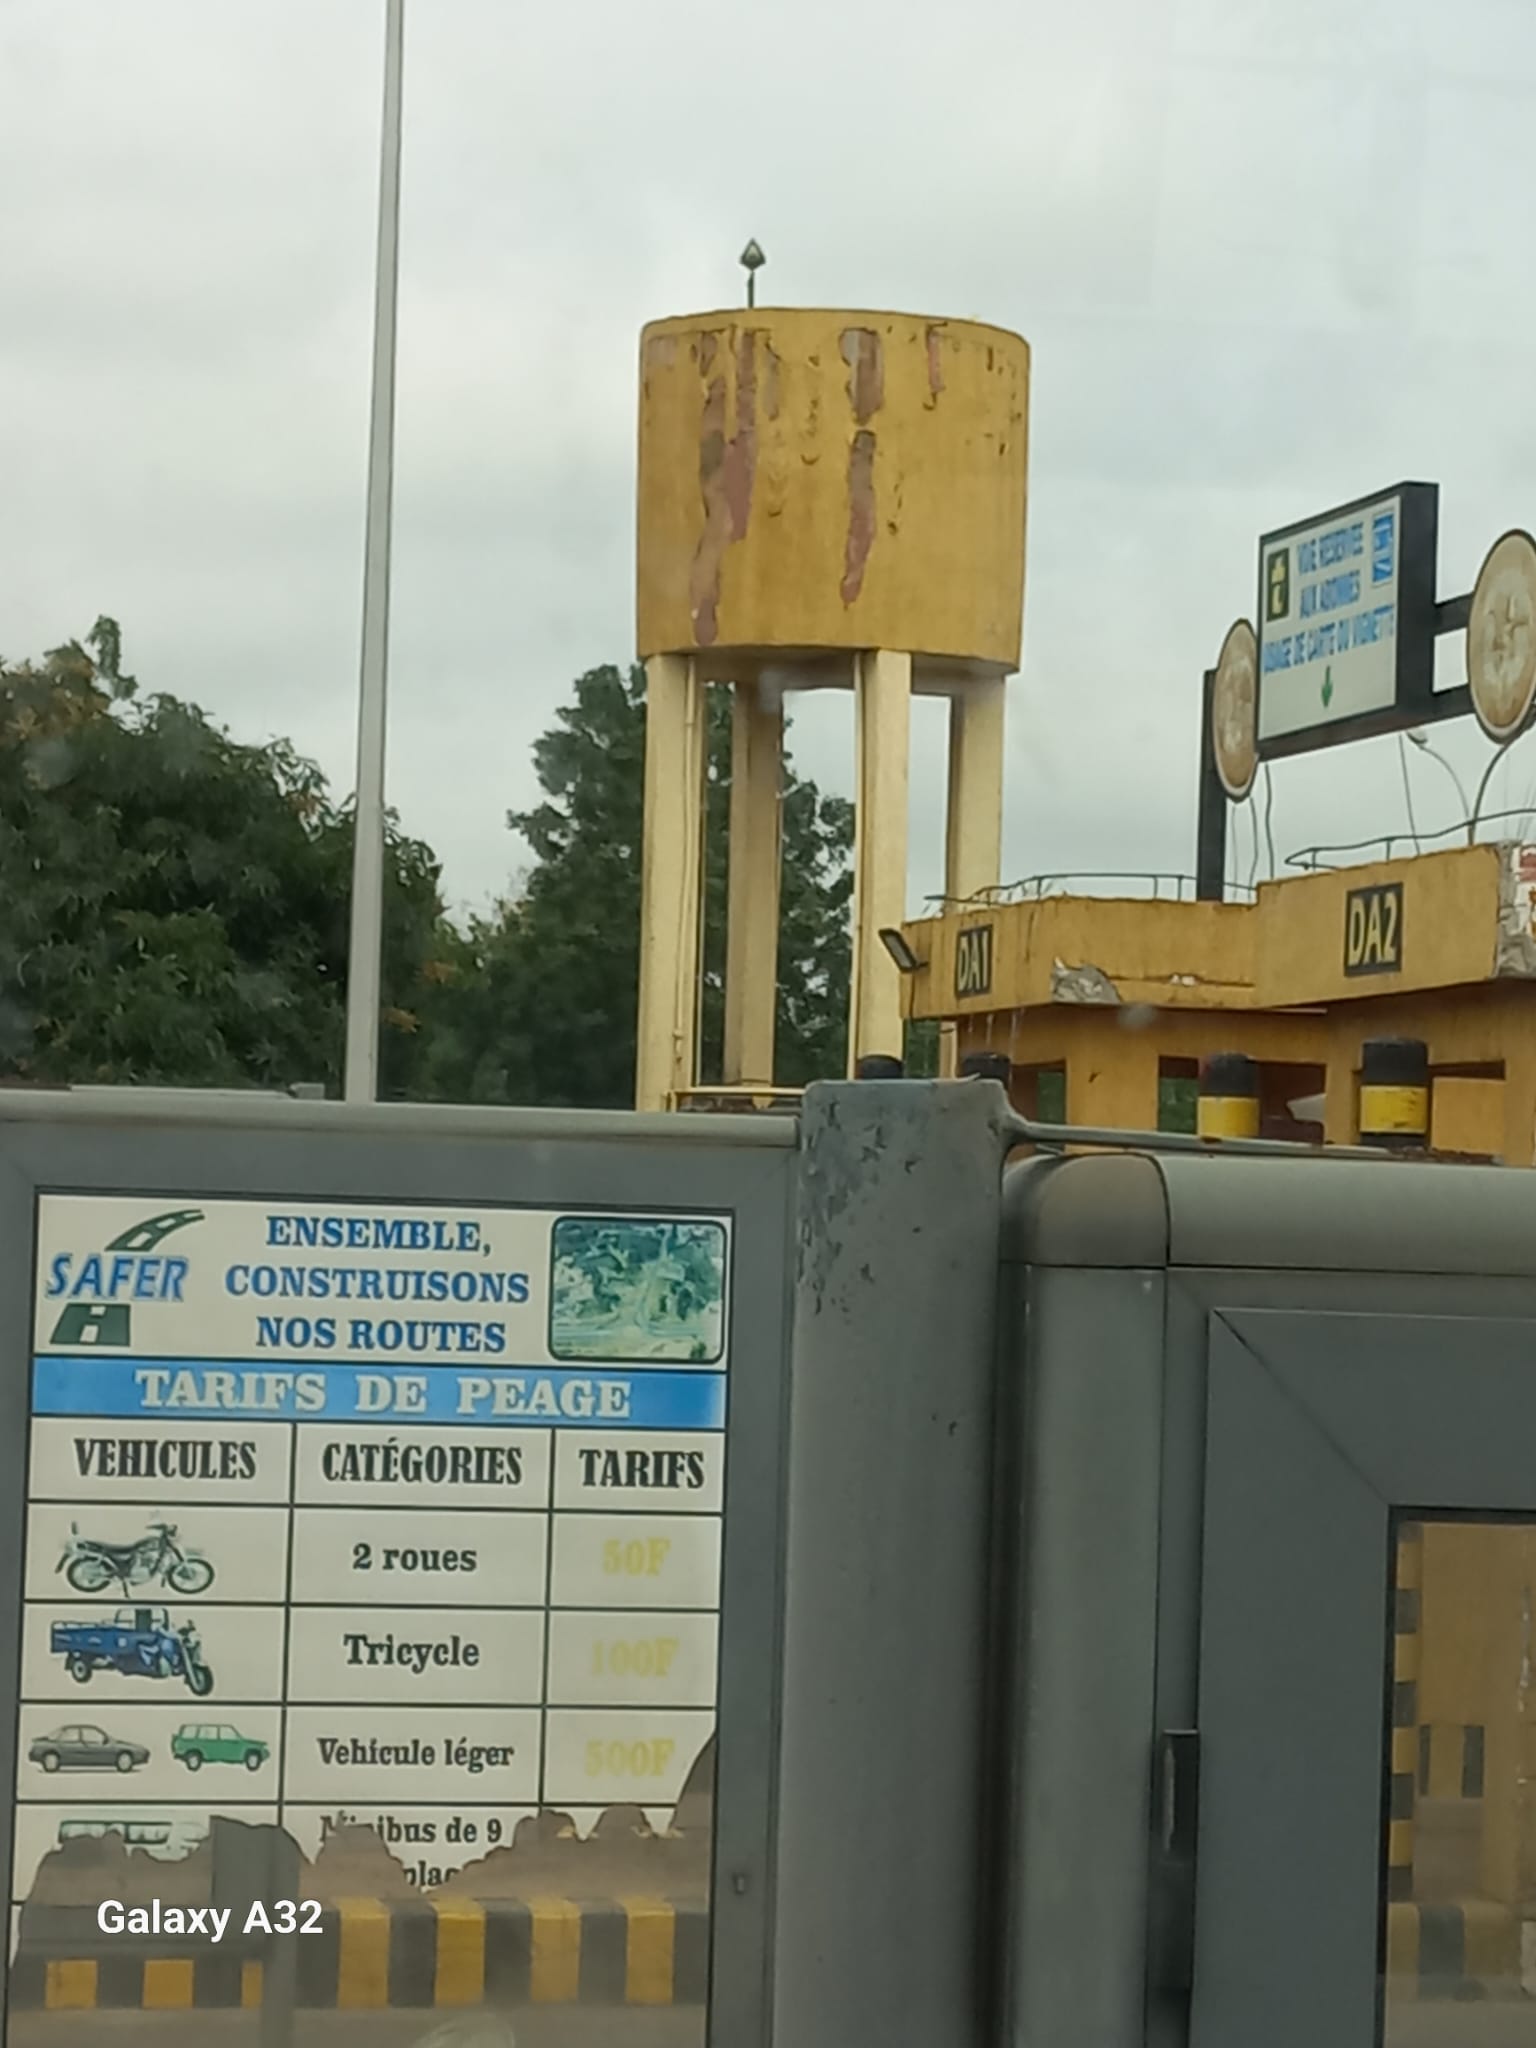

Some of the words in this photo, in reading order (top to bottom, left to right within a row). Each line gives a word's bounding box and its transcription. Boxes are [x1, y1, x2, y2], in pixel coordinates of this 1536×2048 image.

[1348, 893, 1398, 966] DA2
[957, 931, 990, 992] DA1
[266, 1215, 491, 1257] ENSEMBLE,
[47, 1251, 189, 1301] SAFER
[225, 1264, 529, 1303] CONSTRUISONS
[255, 1317, 336, 1349] NOS
[347, 1319, 506, 1354] ROUTES
[135, 1369, 327, 1413] TARIFS
[354, 1374, 427, 1412] DE
[456, 1376, 632, 1418] PEAGE
[73, 1438, 257, 1479] VEHICULES
[322, 1436, 522, 1485] CATÉGORIES
[578, 1449, 705, 1489] TARIFS
[353, 1542, 372, 1570] 2
[382, 1548, 477, 1572] roues
[603, 1536, 671, 1577] 50F
[343, 1633, 480, 1674] Tricycle
[591, 1637, 680, 1678] 100F
[444, 1736, 515, 1774] léger
[585, 1738, 676, 1778] 500F
[319, 1814, 436, 1843] ibus
[445, 1816, 478, 1843] de
[486, 1818, 503, 1844] 9
